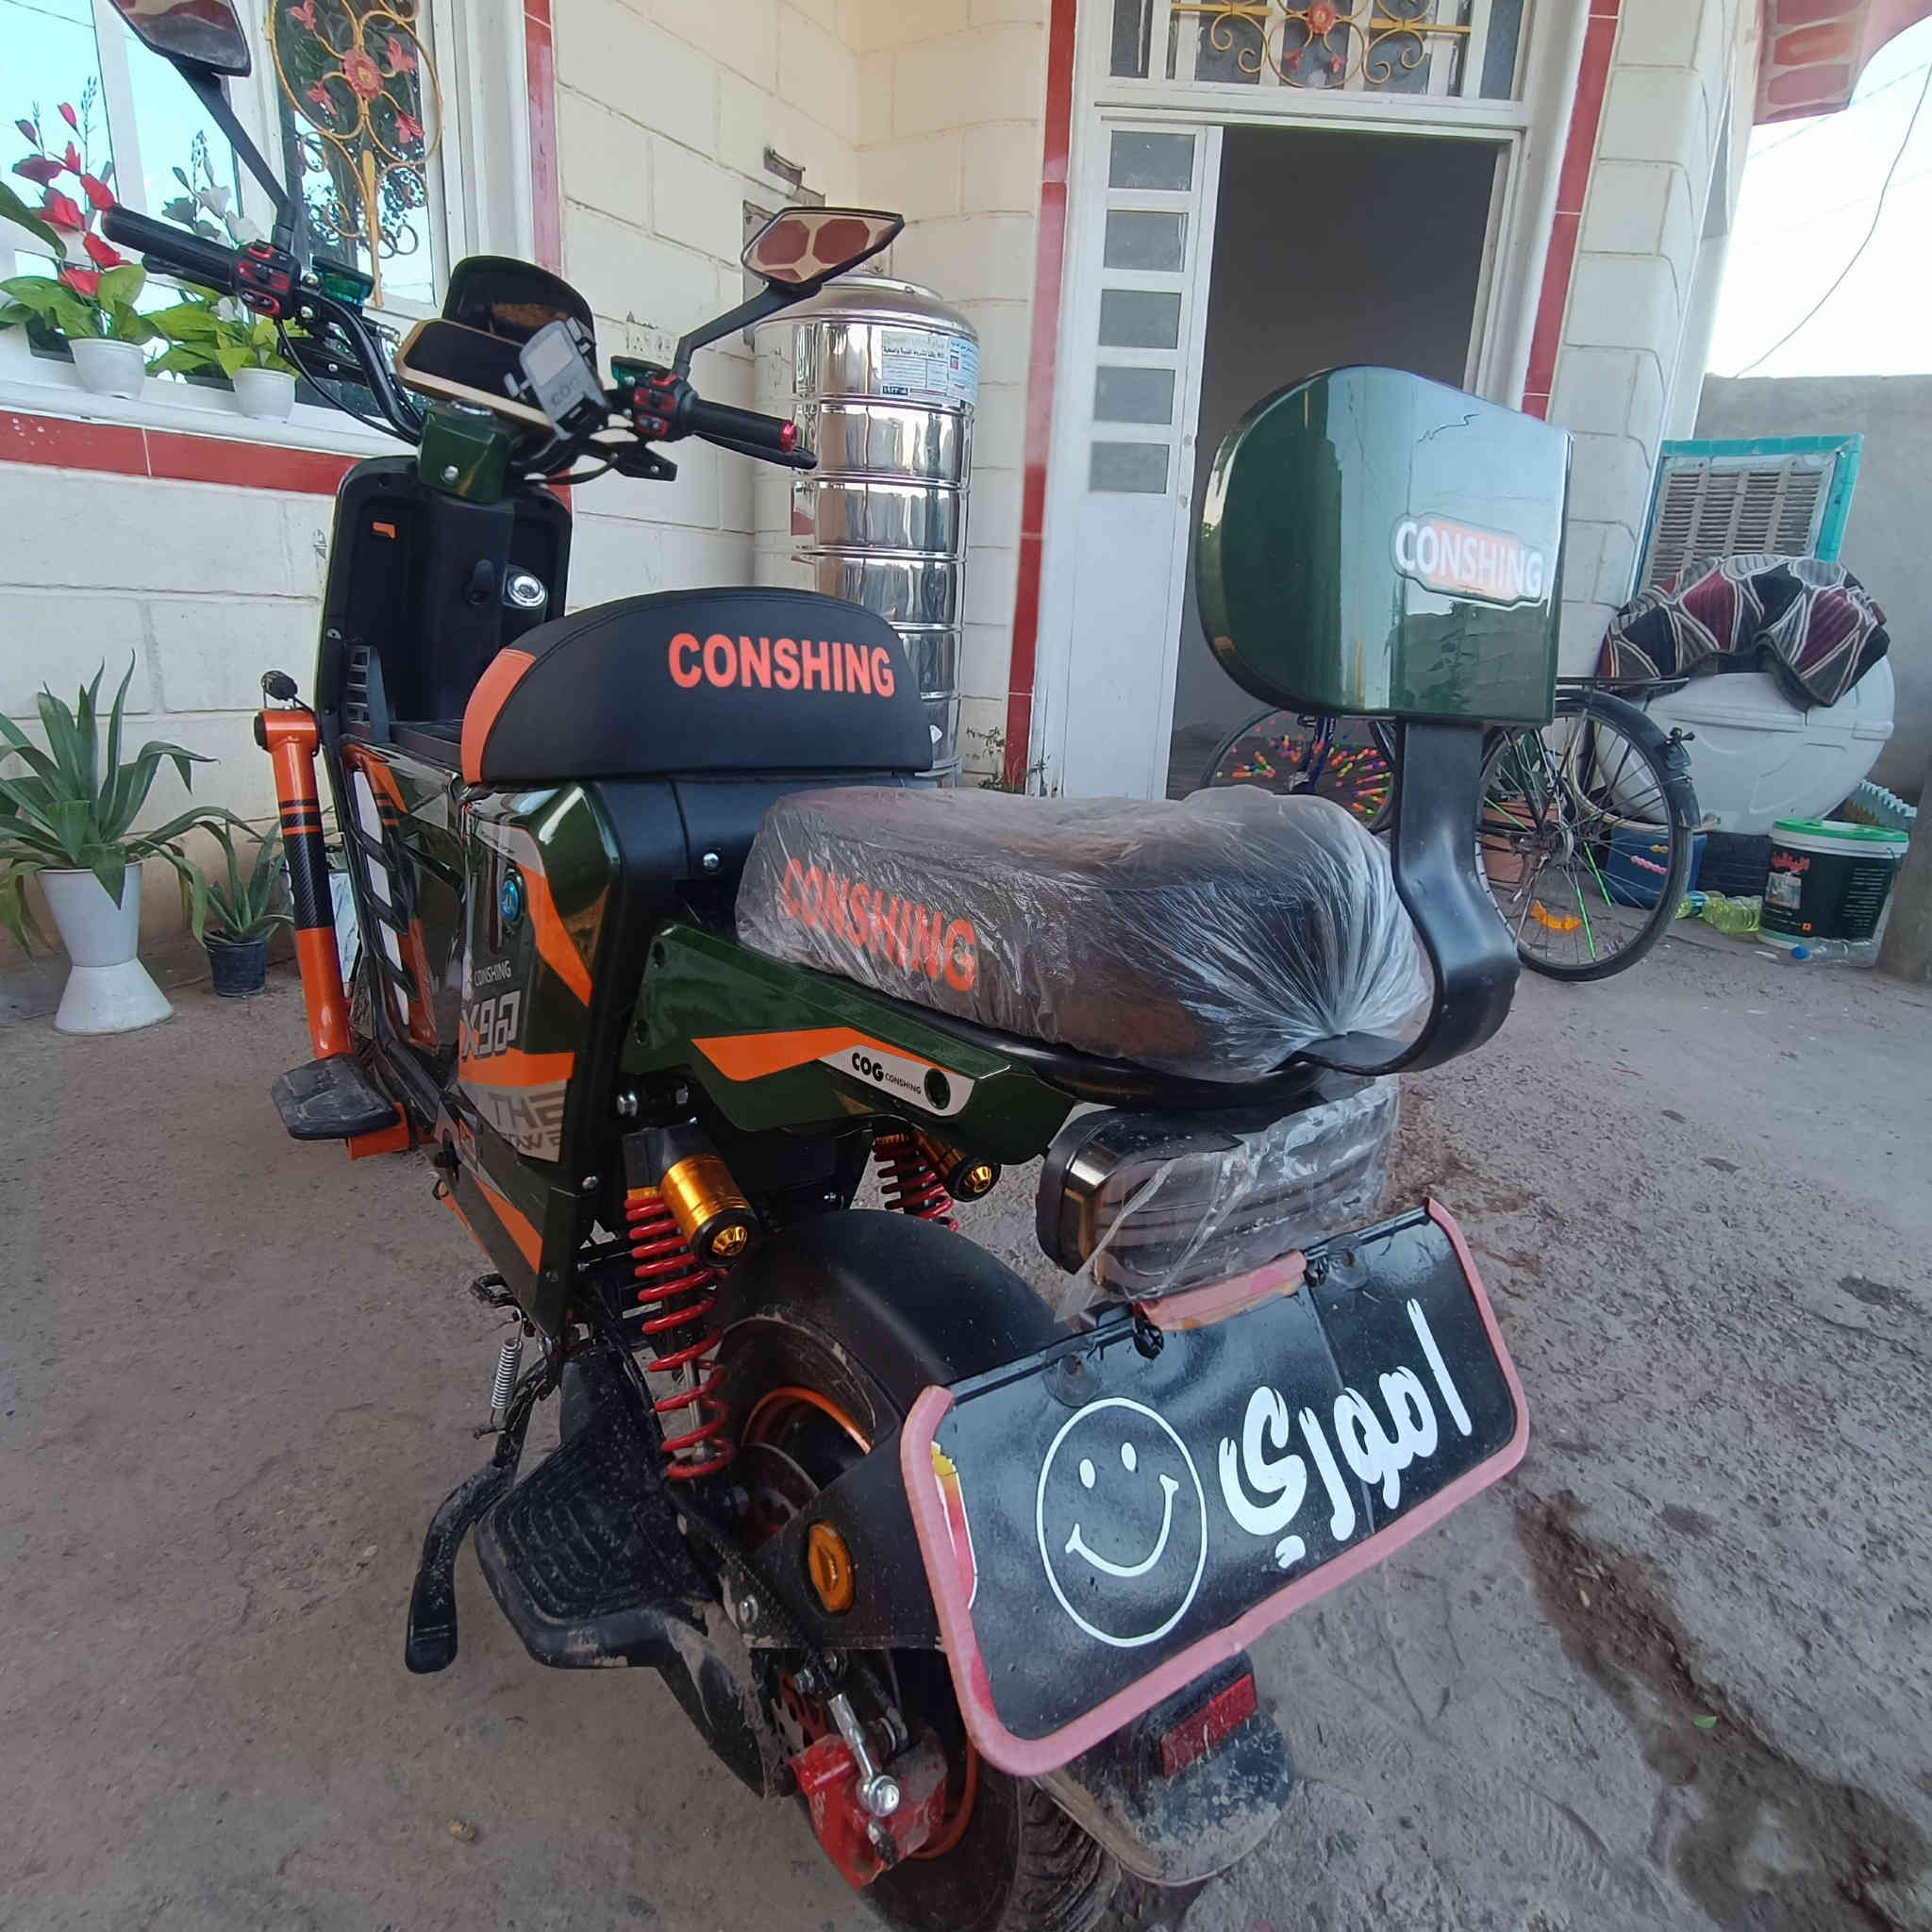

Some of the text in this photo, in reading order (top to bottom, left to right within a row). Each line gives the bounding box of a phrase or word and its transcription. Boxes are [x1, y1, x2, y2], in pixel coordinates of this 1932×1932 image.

[1395, 521, 1544, 596] CONSHING
[668, 633, 895, 698] CONSHING
[782, 858, 978, 991] CONSHING
[475, 960, 512, 987] CONSHING
[852, 1053, 922, 1094] COG CONSHING
[489, 1090, 565, 1128] THE
